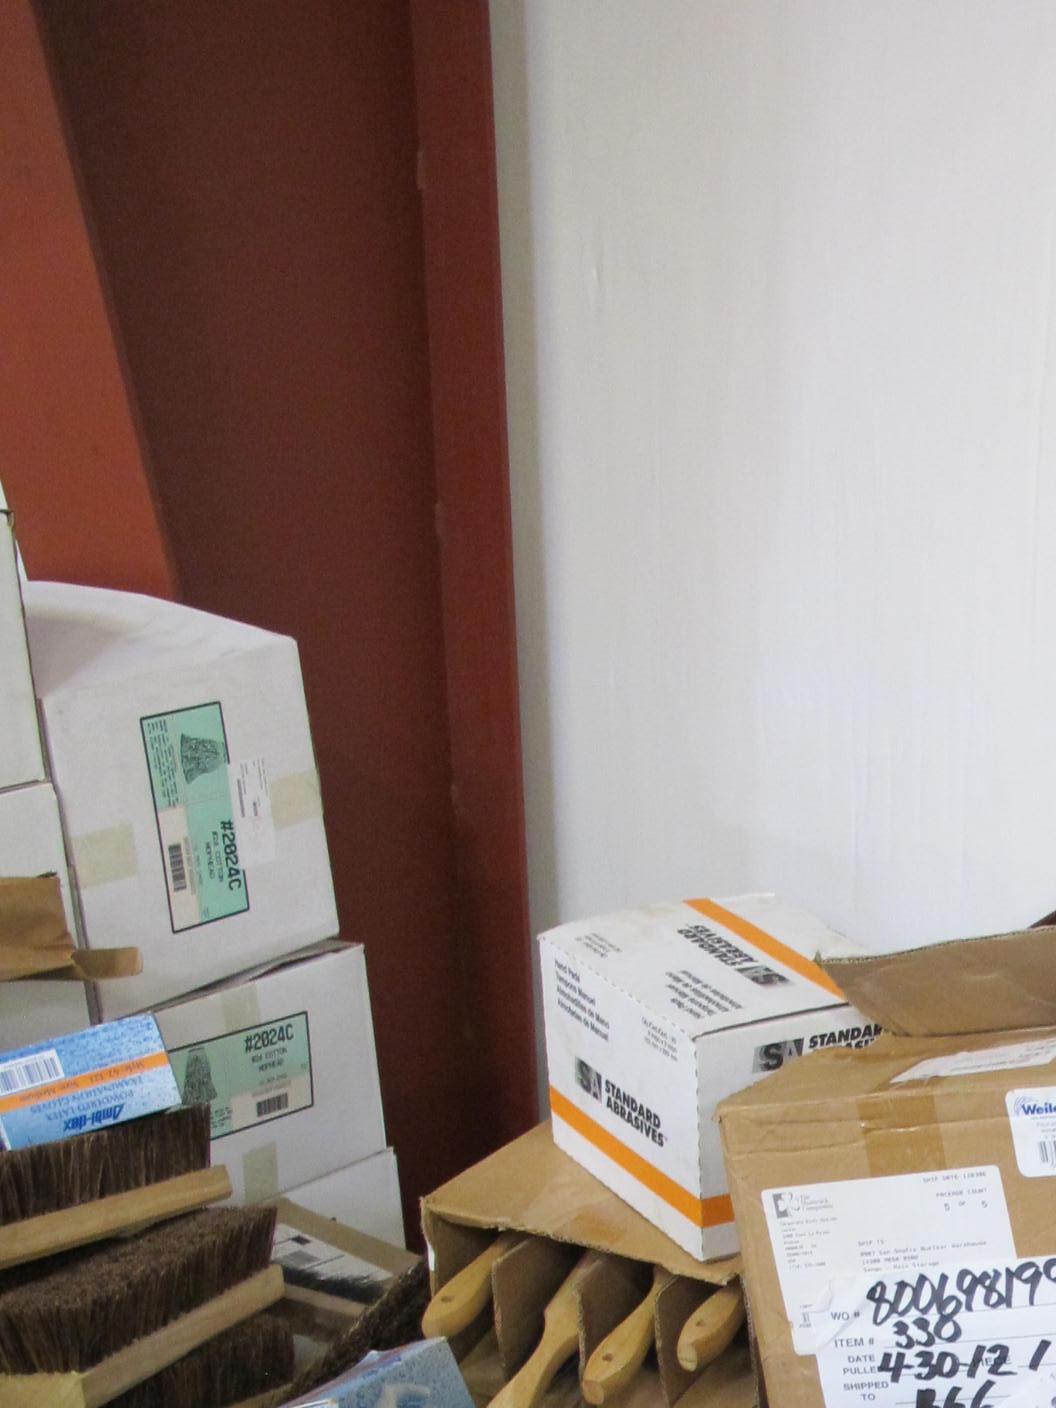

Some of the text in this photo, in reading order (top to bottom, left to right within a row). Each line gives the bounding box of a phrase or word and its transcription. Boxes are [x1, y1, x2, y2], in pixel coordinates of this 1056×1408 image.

[677, 929, 743, 966] STANDARD
[605, 1079, 661, 1129] STANDARD
[63, 1103, 125, 1132] Ambi-dex
[606, 1096, 665, 1147] ABRASIVES
[830, 1311, 850, 1321] WO
[834, 1337, 875, 1348] ITEM #
[847, 1354, 875, 1363] DATE
[843, 1364, 879, 1375] PULLE
[843, 1380, 889, 1391] SHIPPED
[860, 1393, 876, 1401] TO
